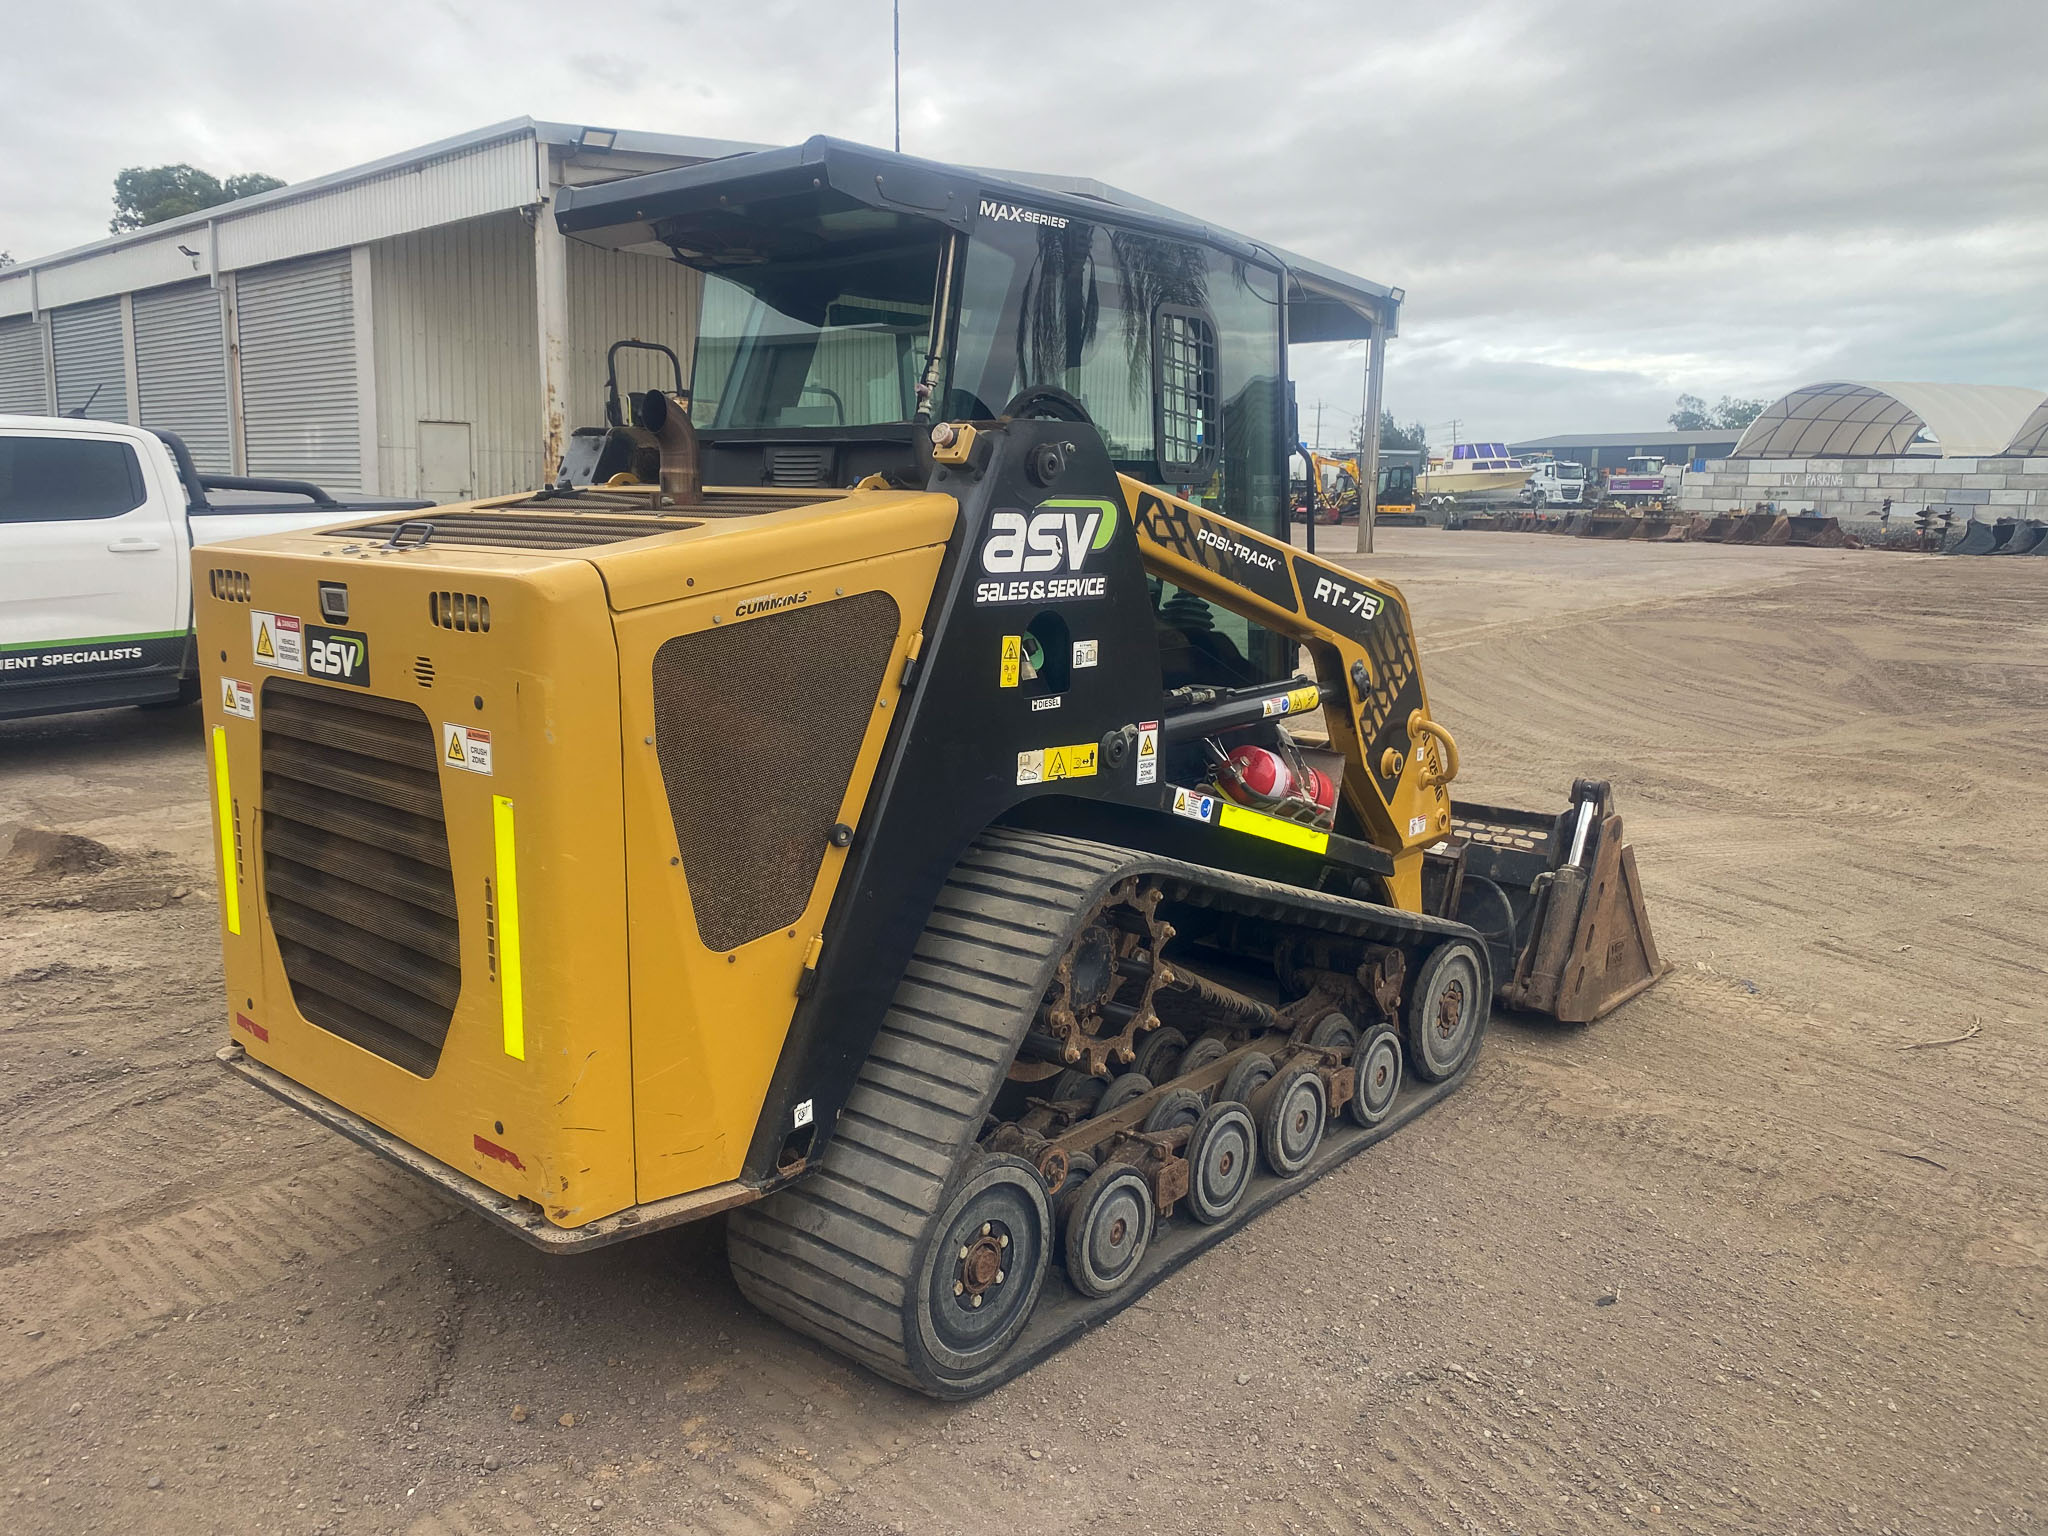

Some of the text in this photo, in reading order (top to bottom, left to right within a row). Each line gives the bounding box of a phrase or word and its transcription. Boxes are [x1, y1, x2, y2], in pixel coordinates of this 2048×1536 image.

[1783, 473, 1843, 487] LV PARKING
[1196, 528, 1277, 571] POSI-TRACK
[1046, 577, 1106, 598] SERVICE
[1313, 576, 1378, 620] RT-75
[735, 591, 808, 617] CUMMINS
[0, 647, 143, 670] ENT SPECIALISTS
[1038, 698, 1060, 709] DIESEL
[470, 746, 488, 756] CRUSH
